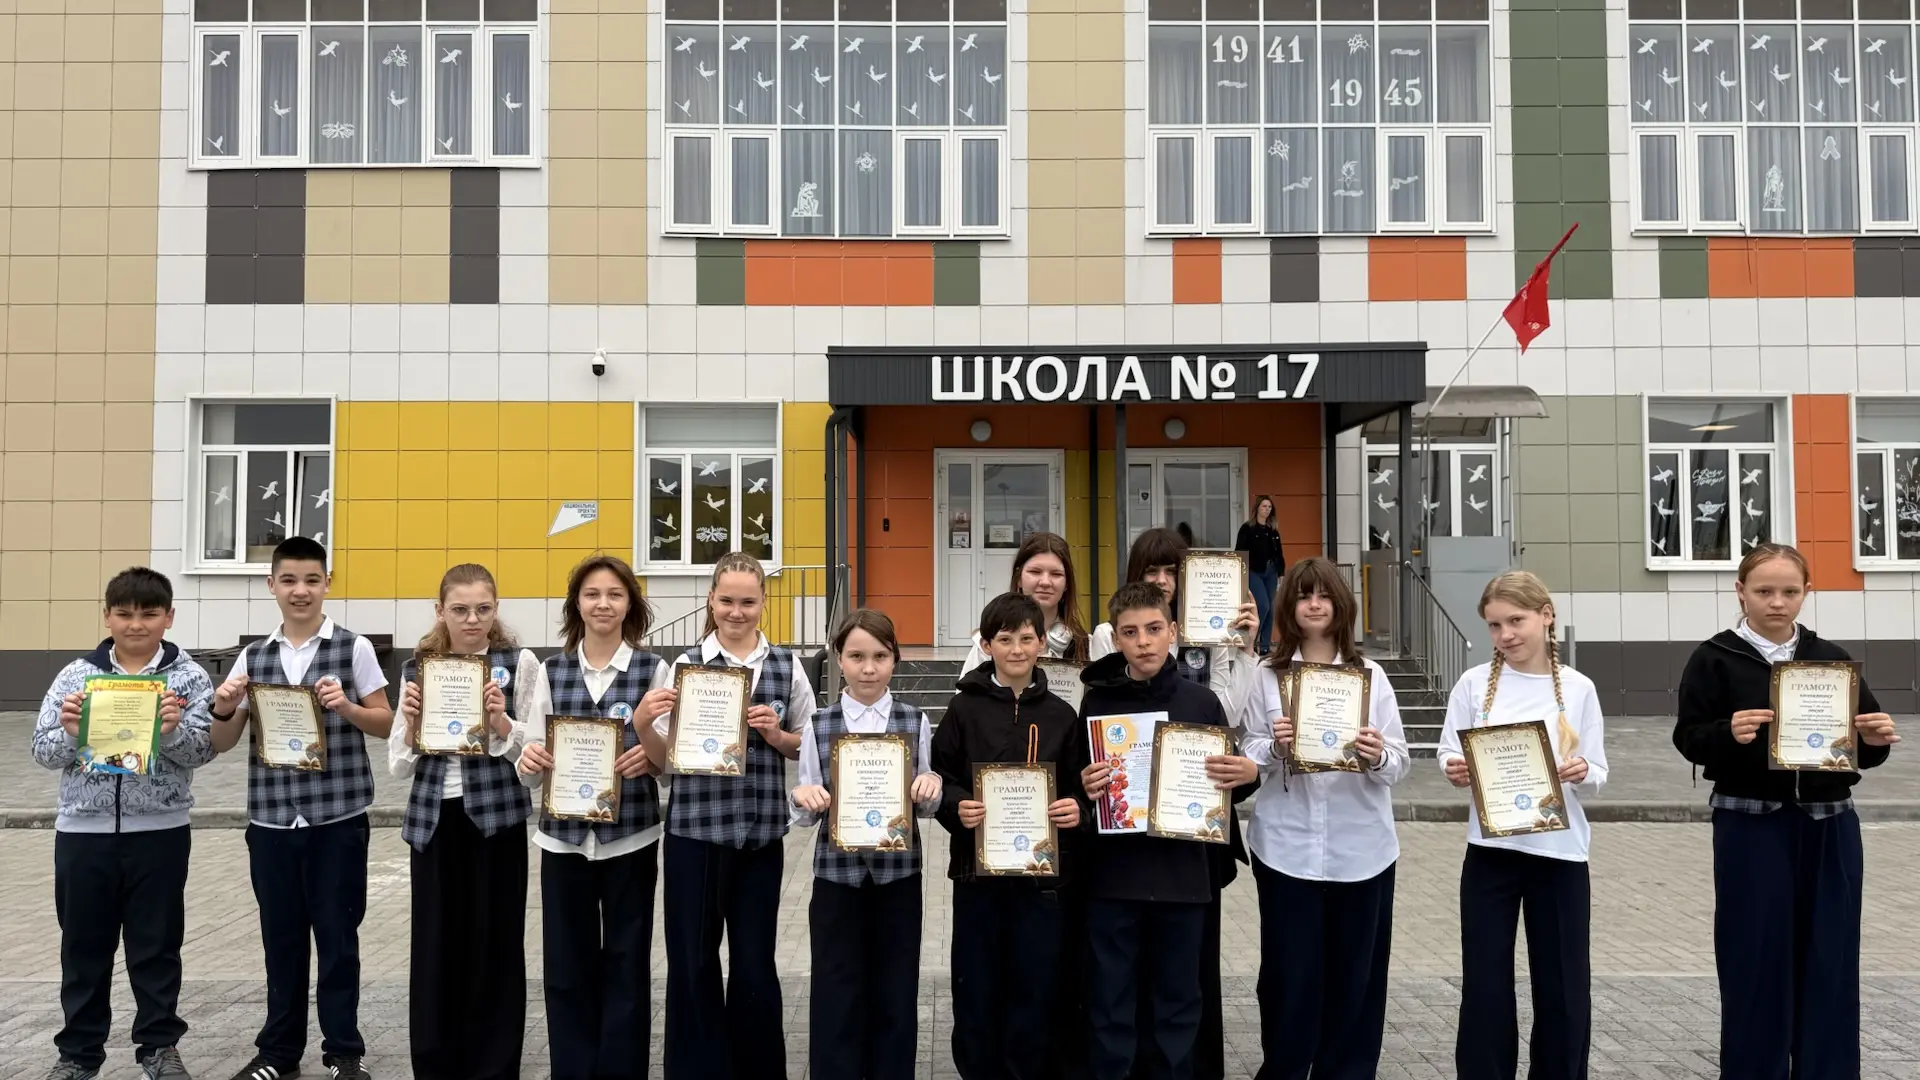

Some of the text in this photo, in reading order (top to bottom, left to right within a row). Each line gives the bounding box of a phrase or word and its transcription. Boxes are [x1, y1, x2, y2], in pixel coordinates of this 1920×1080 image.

[1212, 34, 1304, 63] 19 41
[1329, 77, 1422, 107] 19 45
[931, 353, 1320, 402] ШКОЛА № 17
[1194, 571, 1233, 579] ГРАМОТА
[433, 675, 473, 684] ГРАМОТА
[1049, 679, 1076, 688] АМОТА
[108, 681, 145, 690] Грамота
[1791, 683, 1838, 692] ГРАМОТА
[691, 688, 733, 698] ГРАМОТА
[1310, 685, 1352, 697] ГРАМОТА
[266, 699, 304, 709] ГРАМОТА
[564, 737, 606, 747] ГРАМОТА
[1129, 741, 1153, 750] ГРАМО
[1483, 743, 1531, 755] ГРАМОТА
[849, 759, 894, 767] ГРАМОТА
[993, 786, 1037, 794] ГРАМОТА
